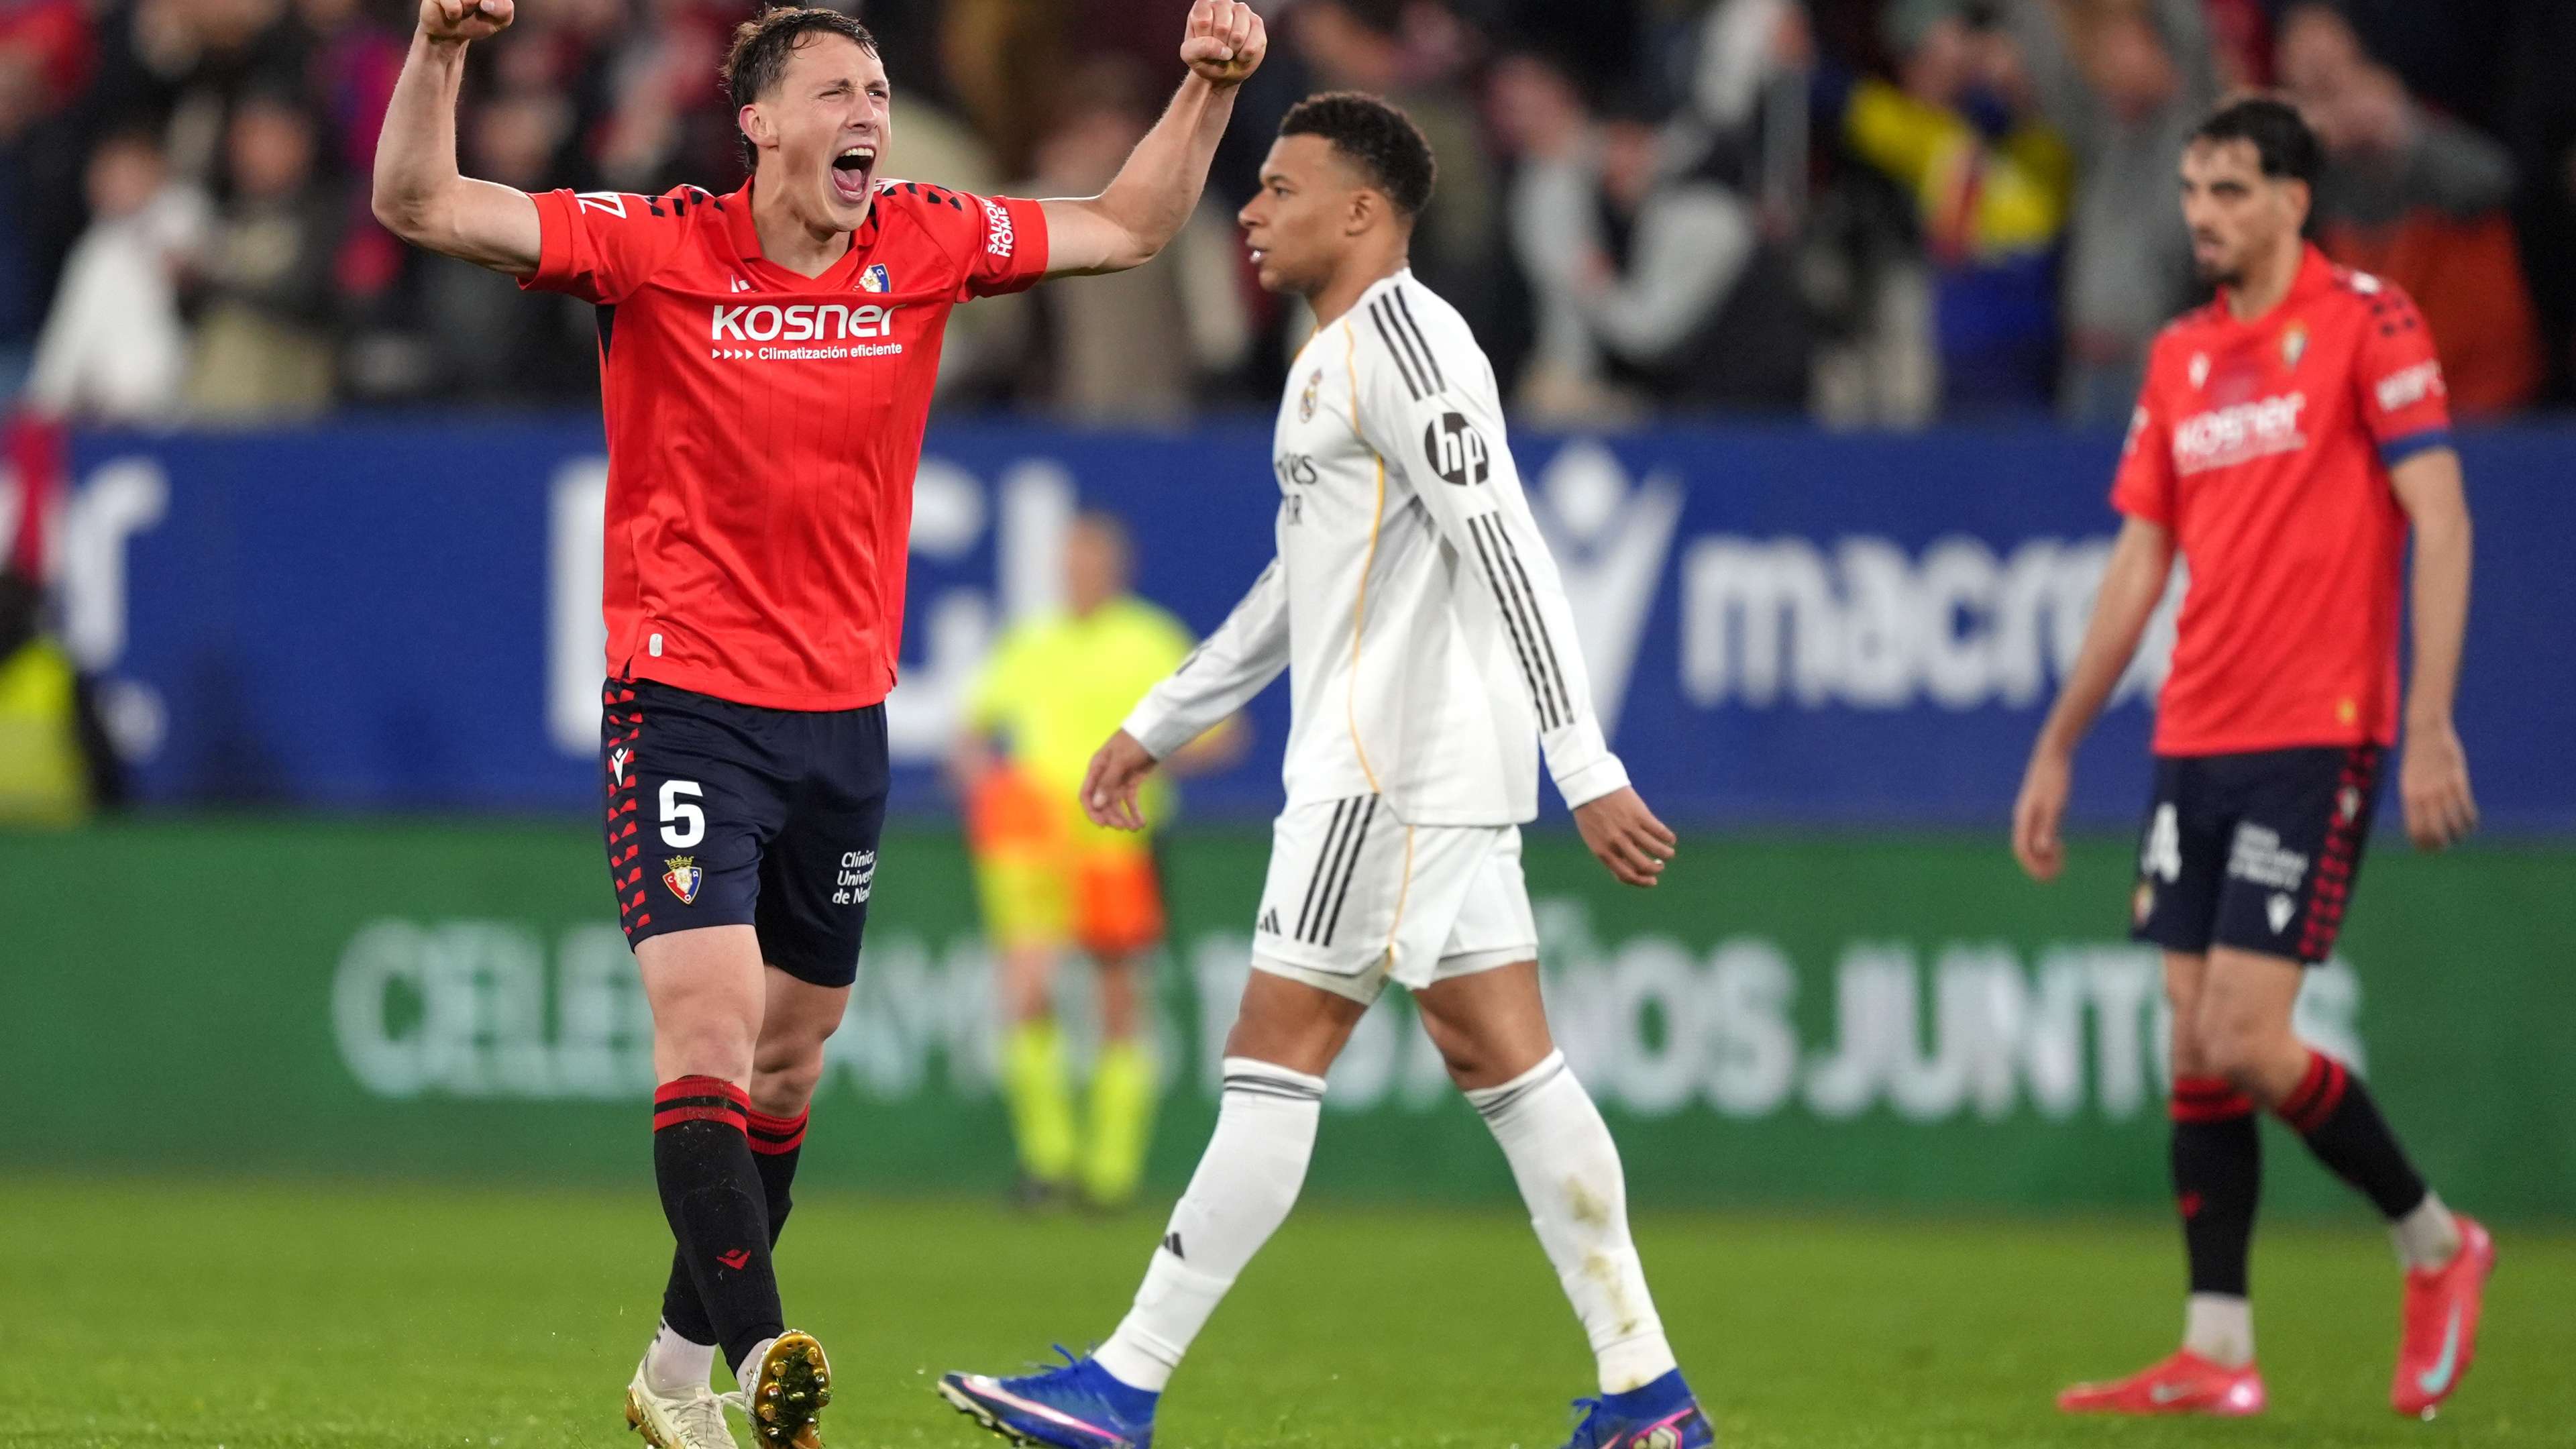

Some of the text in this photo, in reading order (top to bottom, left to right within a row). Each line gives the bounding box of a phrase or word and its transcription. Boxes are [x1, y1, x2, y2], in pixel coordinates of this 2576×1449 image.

[997, 207, 1014, 258] HOME
[758, 343, 902, 360] Climatización eficiente
[1433, 413, 1486, 486] hp
[659, 780, 705, 848] 5
[832, 888, 850, 904] de
